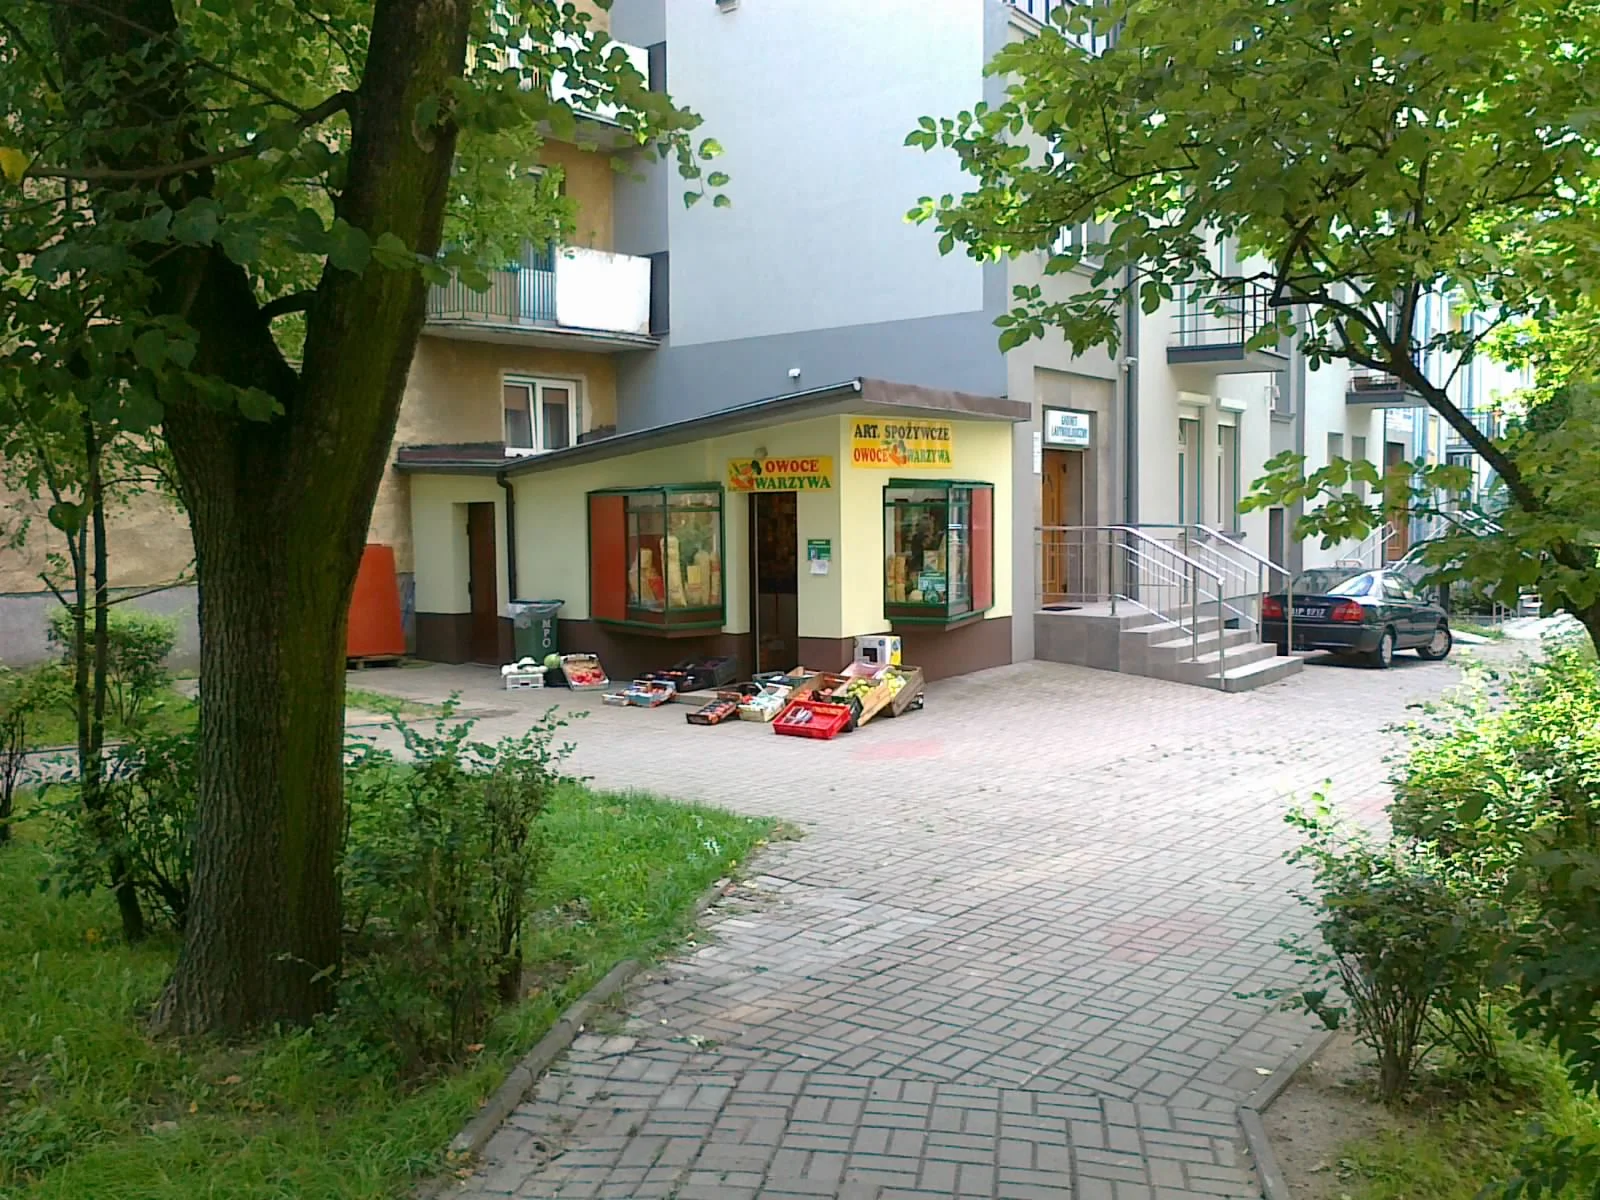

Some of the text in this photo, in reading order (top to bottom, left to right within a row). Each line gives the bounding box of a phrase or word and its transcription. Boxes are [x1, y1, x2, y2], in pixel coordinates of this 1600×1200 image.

[854, 421, 950, 441] ART. SPOŻYWCZE
[853, 447, 951, 464] OWOCE WARZYWA
[765, 459, 819, 473] OWOCE
[755, 475, 832, 489] WARZYWA
[542, 619, 551, 648] MPO
